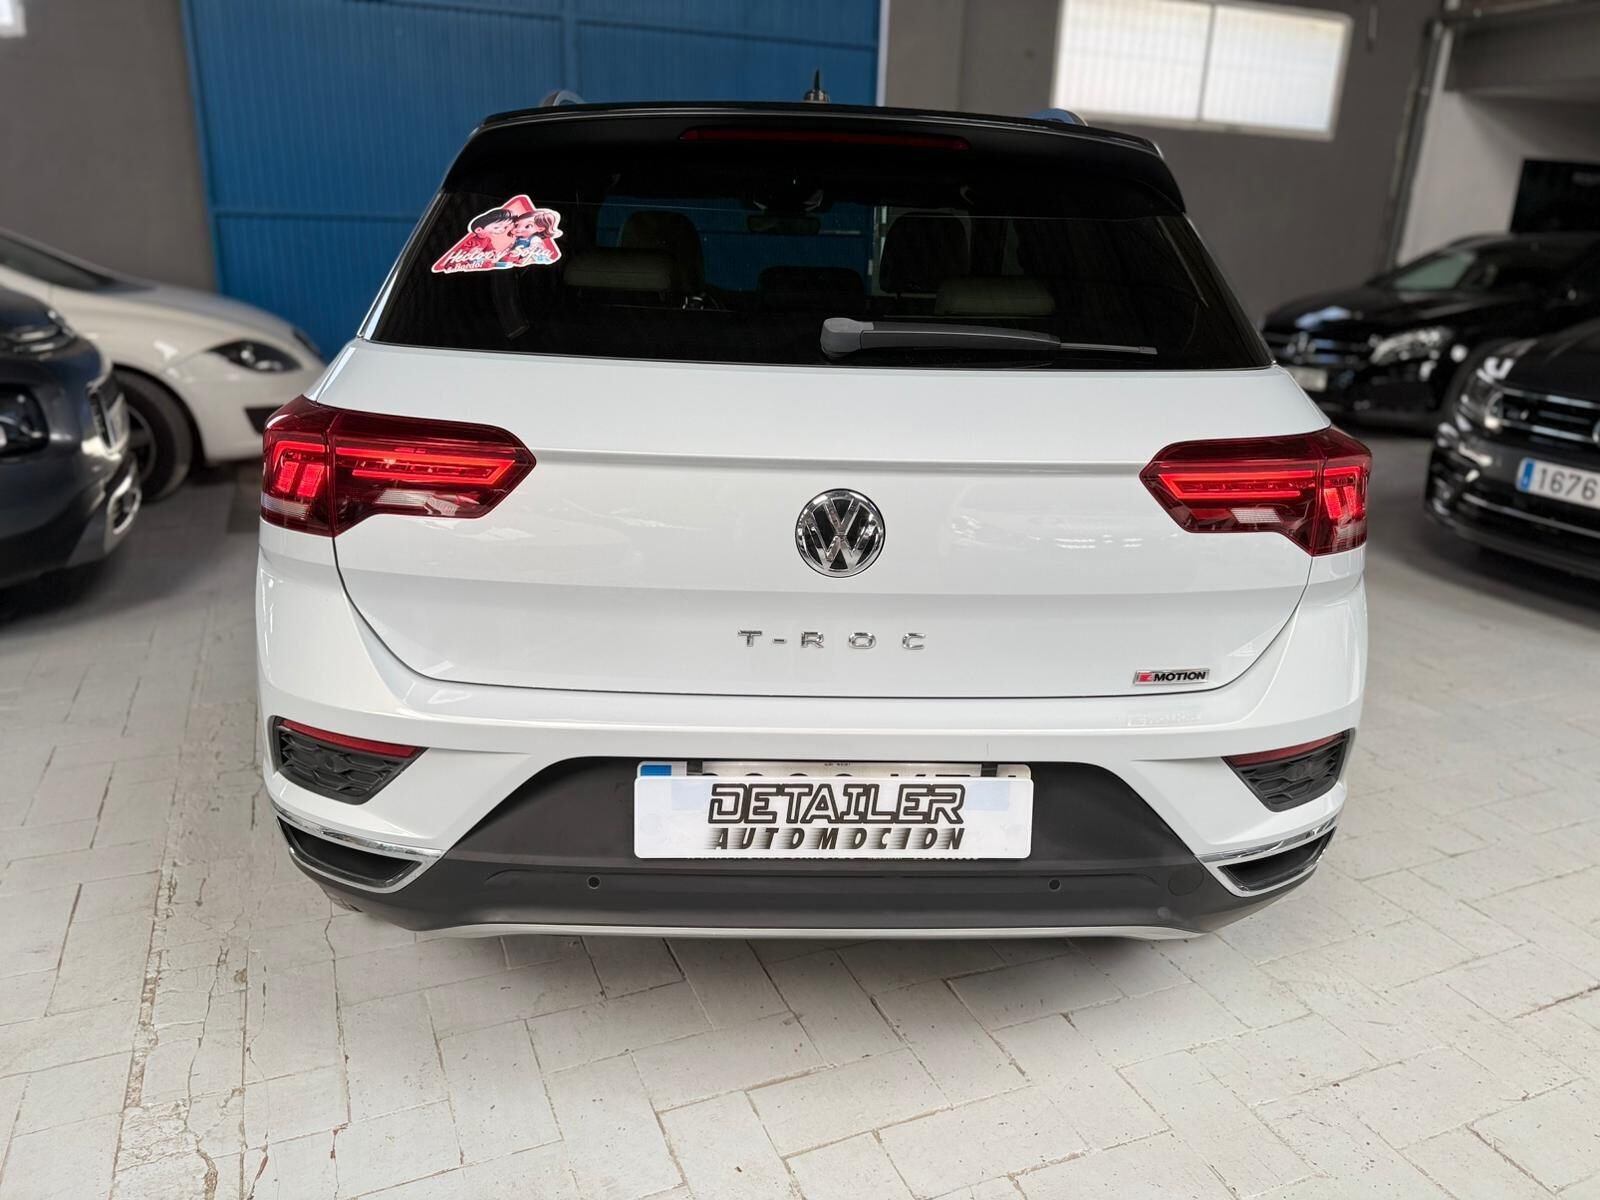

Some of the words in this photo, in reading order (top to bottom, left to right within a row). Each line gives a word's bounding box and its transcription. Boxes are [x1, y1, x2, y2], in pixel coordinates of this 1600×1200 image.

[1538, 467, 1598, 501] 1676
[738, 630, 927, 650] T-ROC
[708, 783, 966, 824] DETAILER
[704, 827, 965, 850] AUTOMOCION
